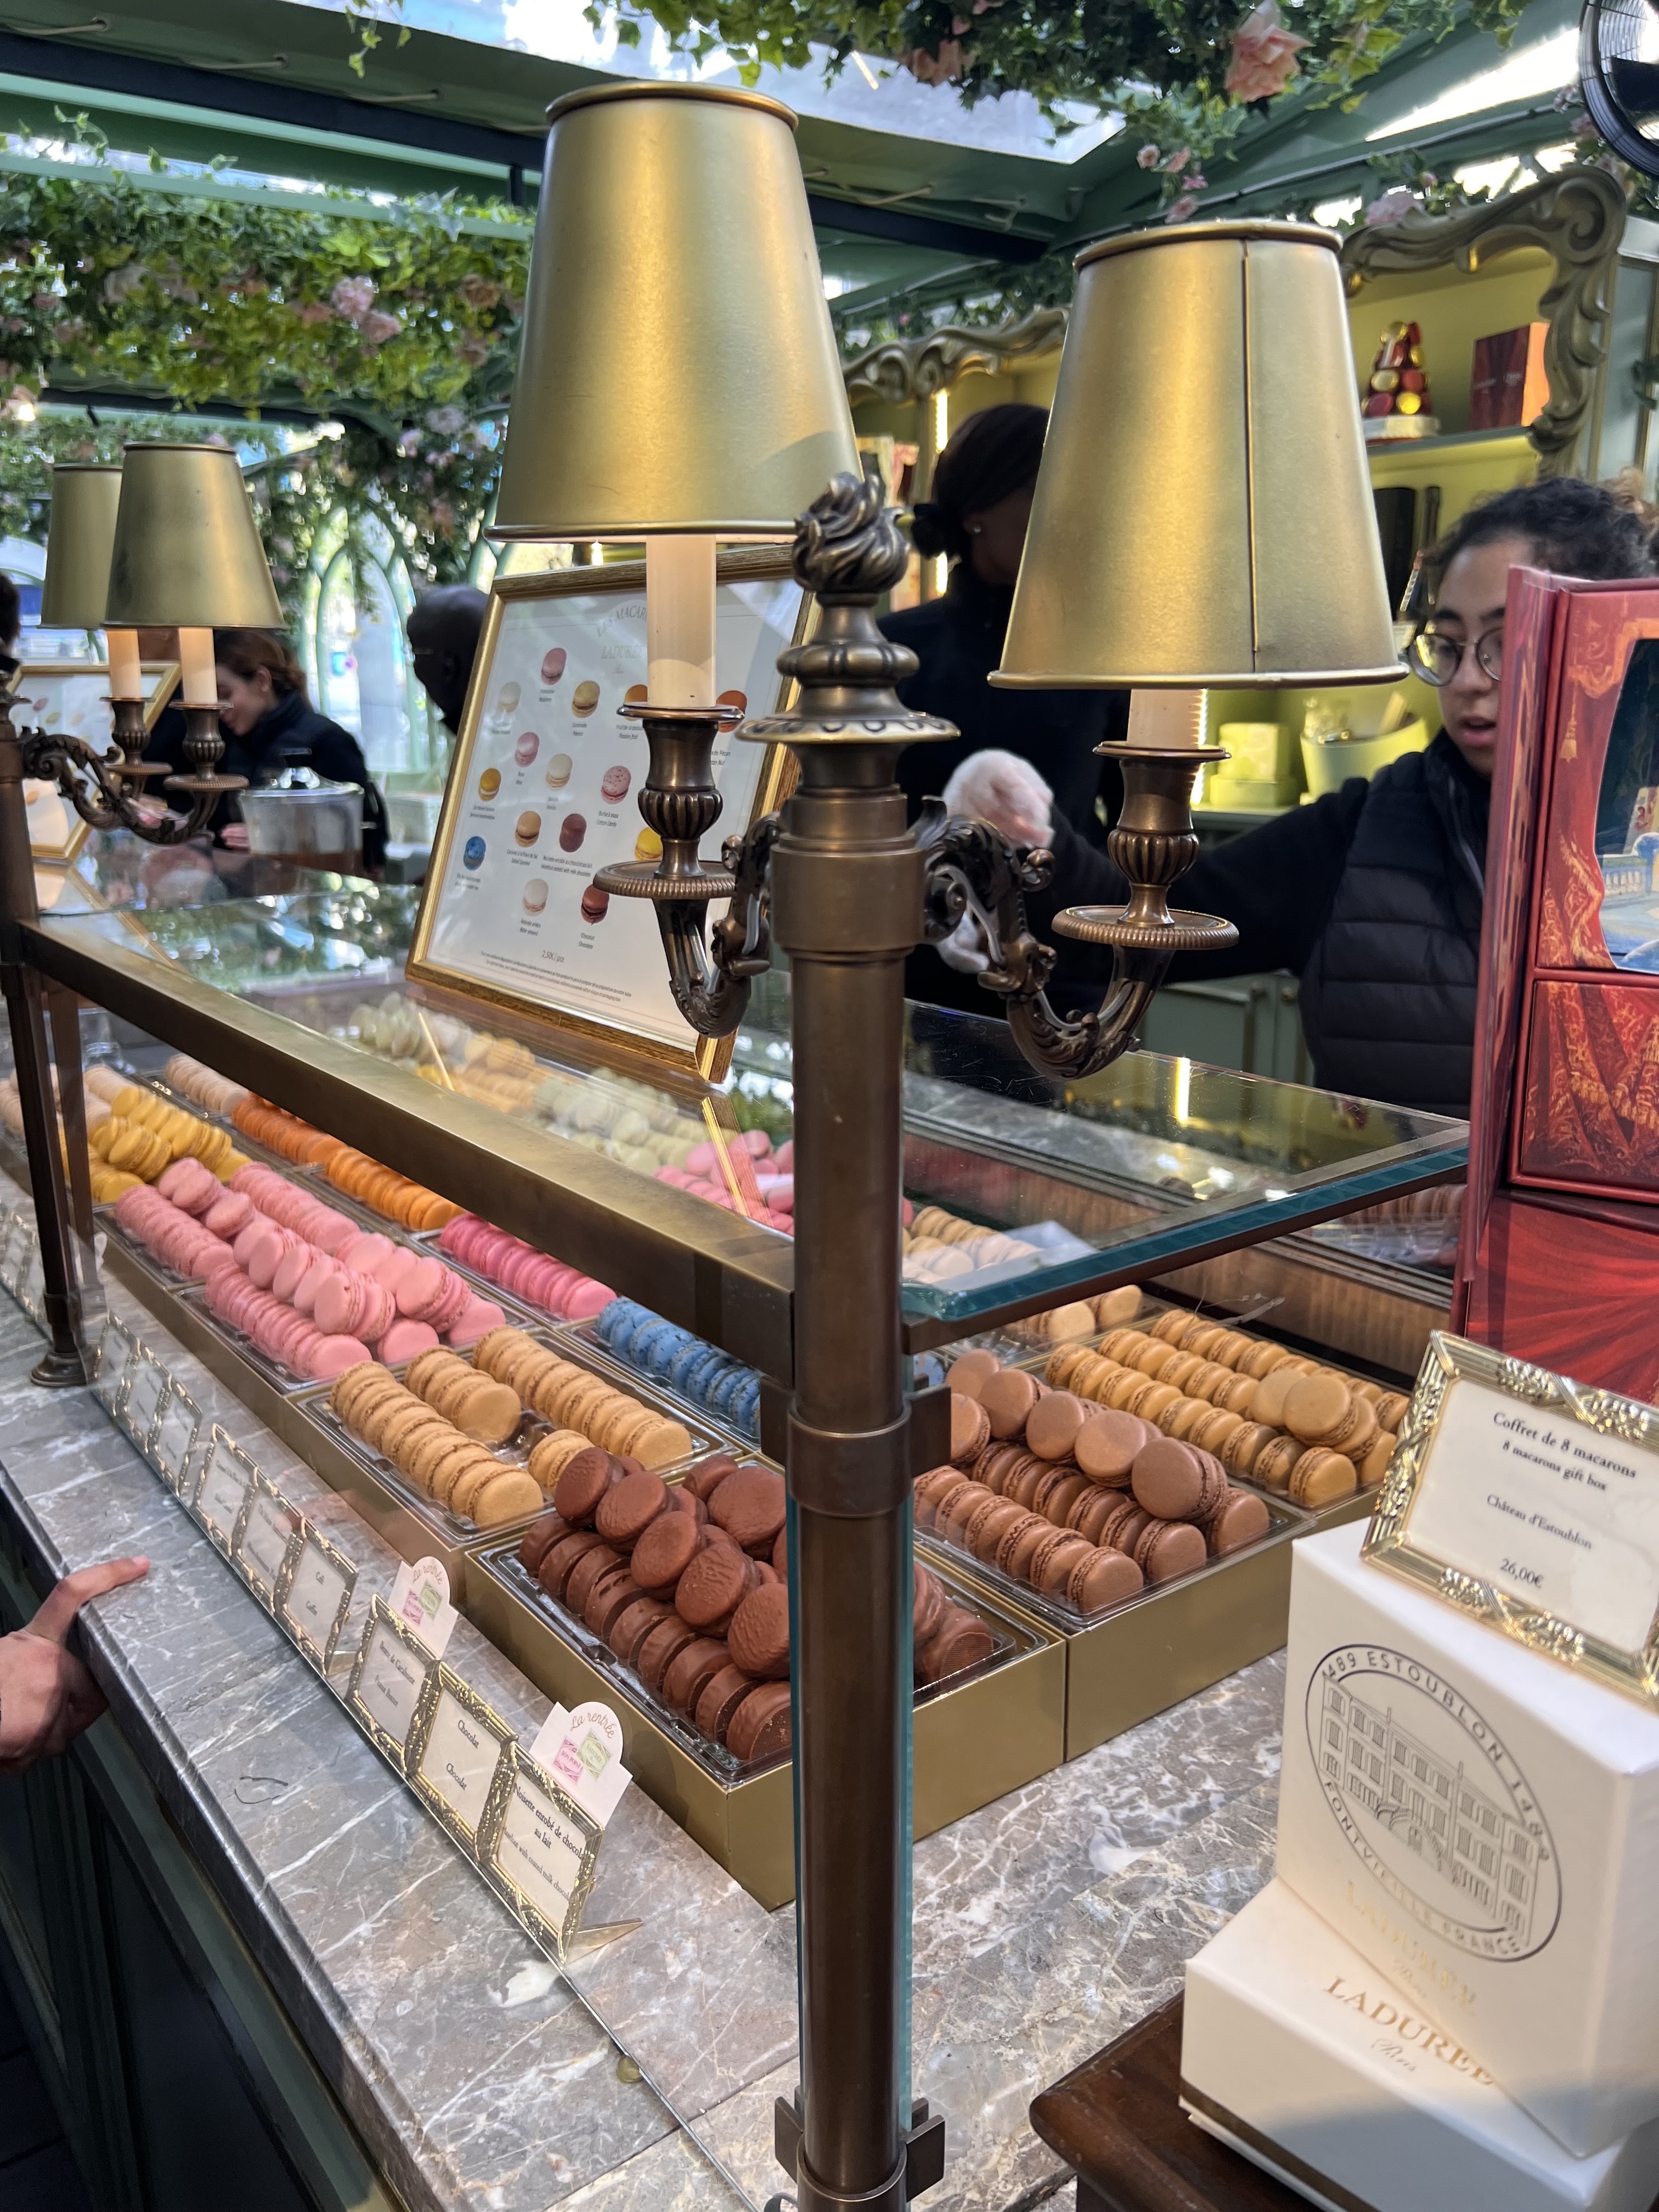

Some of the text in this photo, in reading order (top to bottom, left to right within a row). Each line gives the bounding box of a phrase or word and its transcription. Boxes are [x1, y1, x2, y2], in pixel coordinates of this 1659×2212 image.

[1493, 1412, 1637, 1478] Coffret de 8 macarons
[1503, 1440, 1607, 1491] 8 macarons gift box
[1487, 1494, 1593, 1550] Château d'Estoublon
[1500, 1557, 1544, 1589] 26,00€
[571, 1712, 614, 1739] La rentrée
[1367, 1650, 1504, 1762] ESTOUBLON
[458, 1719, 480, 1750] Chocolat
[446, 1763, 468, 1791] Chocolat
[515, 1783, 535, 1813] Noisette
[535, 1808, 554, 1831] enrobé
[554, 1827, 562, 1839] de
[534, 1827, 552, 1849] au lait
